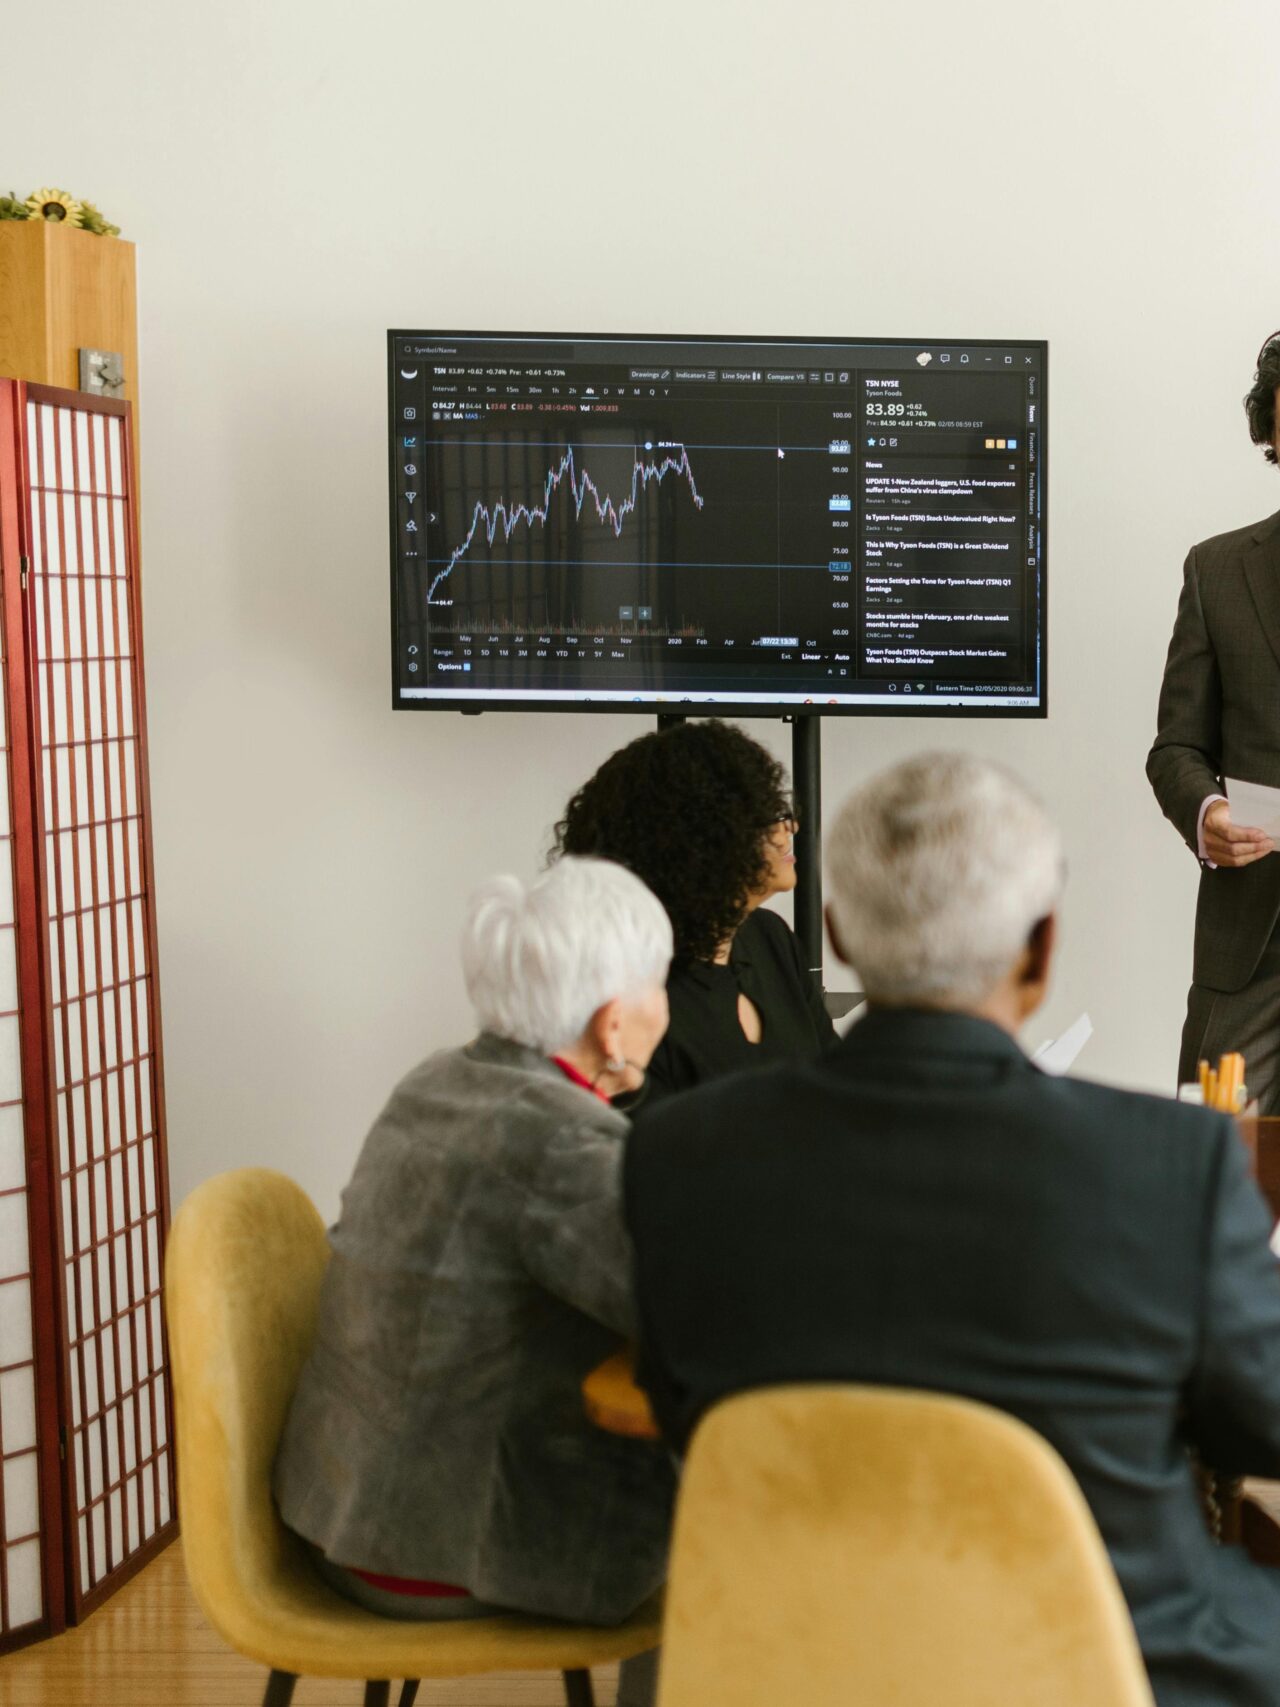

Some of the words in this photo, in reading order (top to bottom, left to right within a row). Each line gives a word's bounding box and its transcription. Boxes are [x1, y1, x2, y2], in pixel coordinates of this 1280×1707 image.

[631, 371, 660, 379] Drawings
[675, 371, 706, 379] Indicators
[736, 373, 751, 381] Style
[767, 374, 794, 382] Compare
[866, 390, 883, 398] Tyson
[865, 403, 905, 416] 83.89
[986, 480, 1016, 488] exporters
[938, 488, 973, 496] clampdown
[872, 514, 890, 522] Tyson
[899, 542, 917, 550] Tyson
[947, 578, 965, 586] Tyson
[865, 586, 892, 594] Earnings
[924, 614, 952, 622] February,
[866, 648, 884, 656] Tyson
[919, 649, 948, 657] Outpaces
[437, 663, 462, 671] Options
